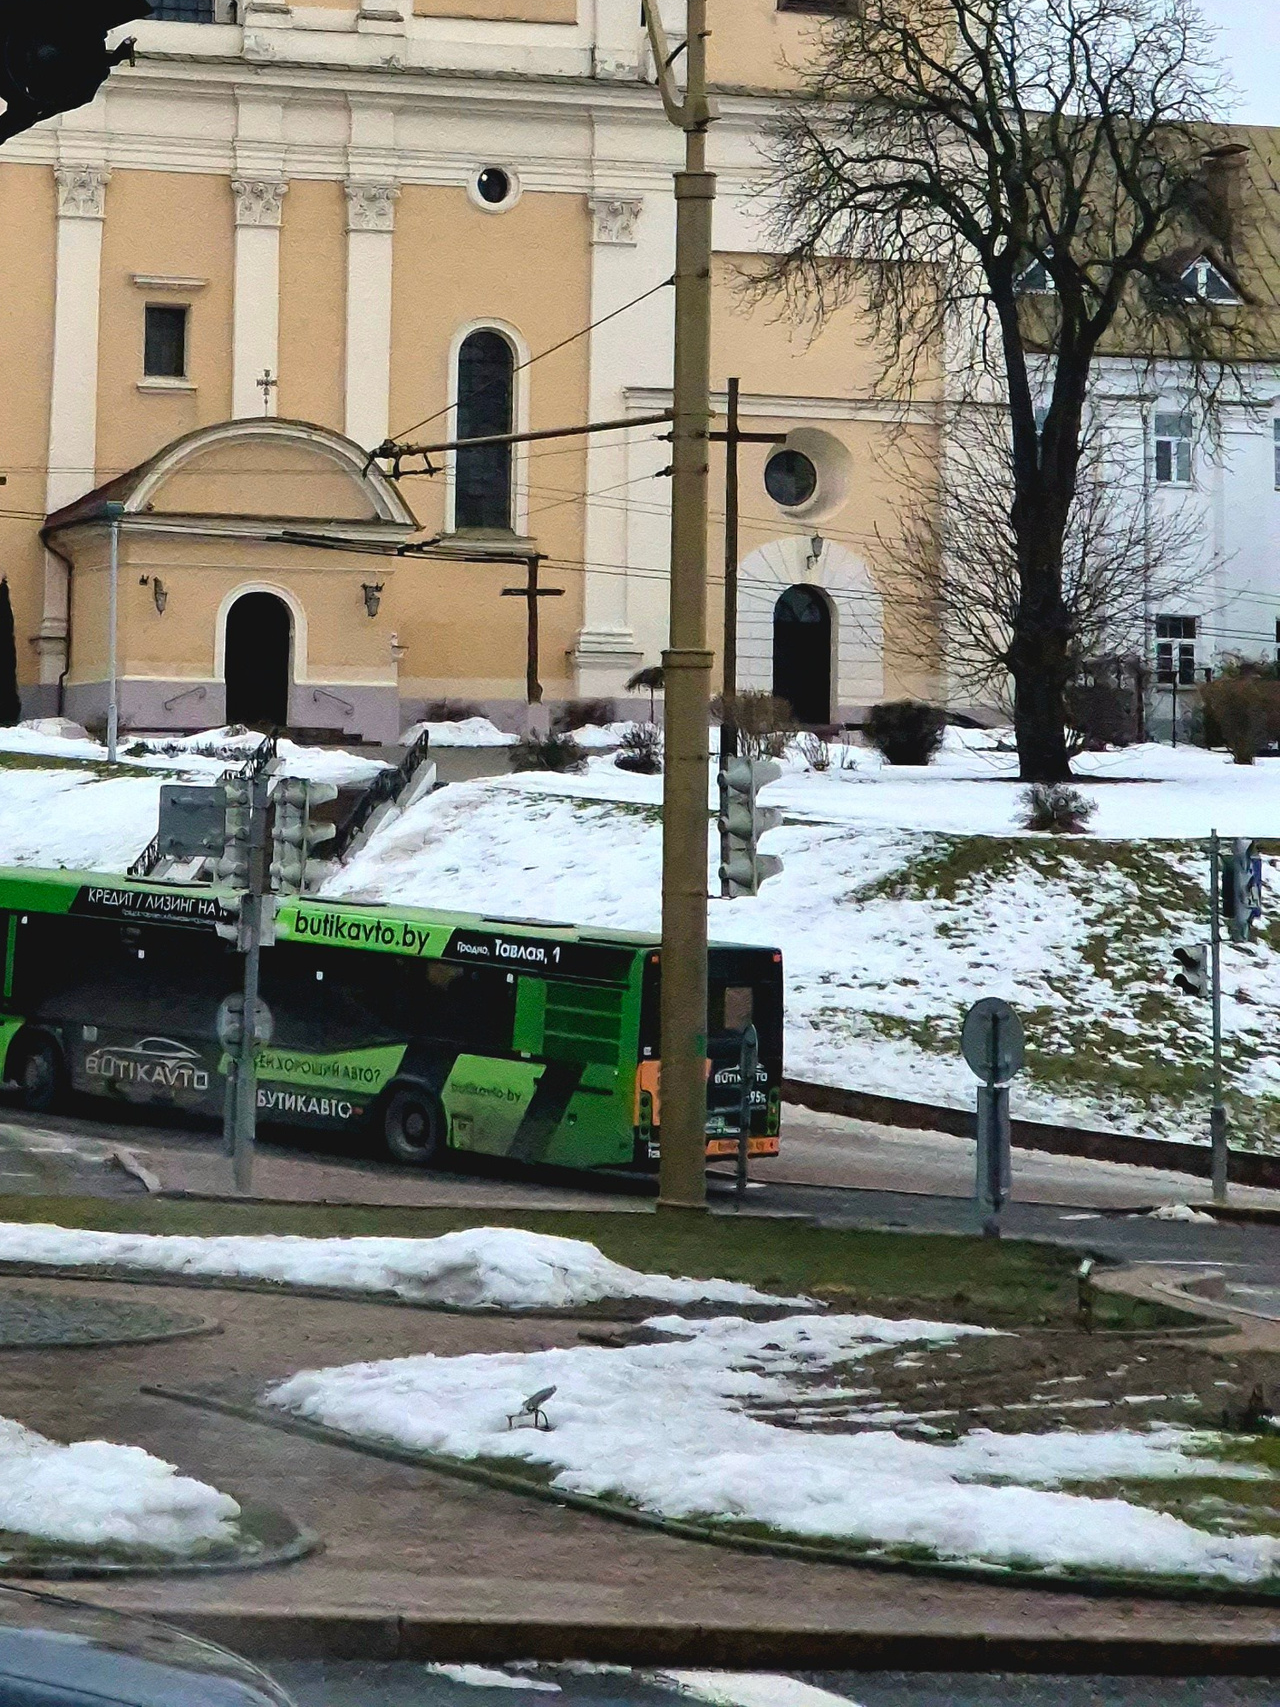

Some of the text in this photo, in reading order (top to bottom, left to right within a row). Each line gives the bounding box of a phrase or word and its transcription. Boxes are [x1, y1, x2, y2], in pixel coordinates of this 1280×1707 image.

[87, 887, 134, 907] КРЕДИТ
[145, 894, 195, 913] ЛИЗИНГ
[198, 902, 217, 917] НА
[294, 909, 431, 956] butikavto.by
[494, 938, 549, 965] Тавлая,
[551, 946, 561, 964] 1
[85, 1055, 209, 1091] BUTIKAVTO
[256, 1088, 353, 1119] БУТИКАВТО
